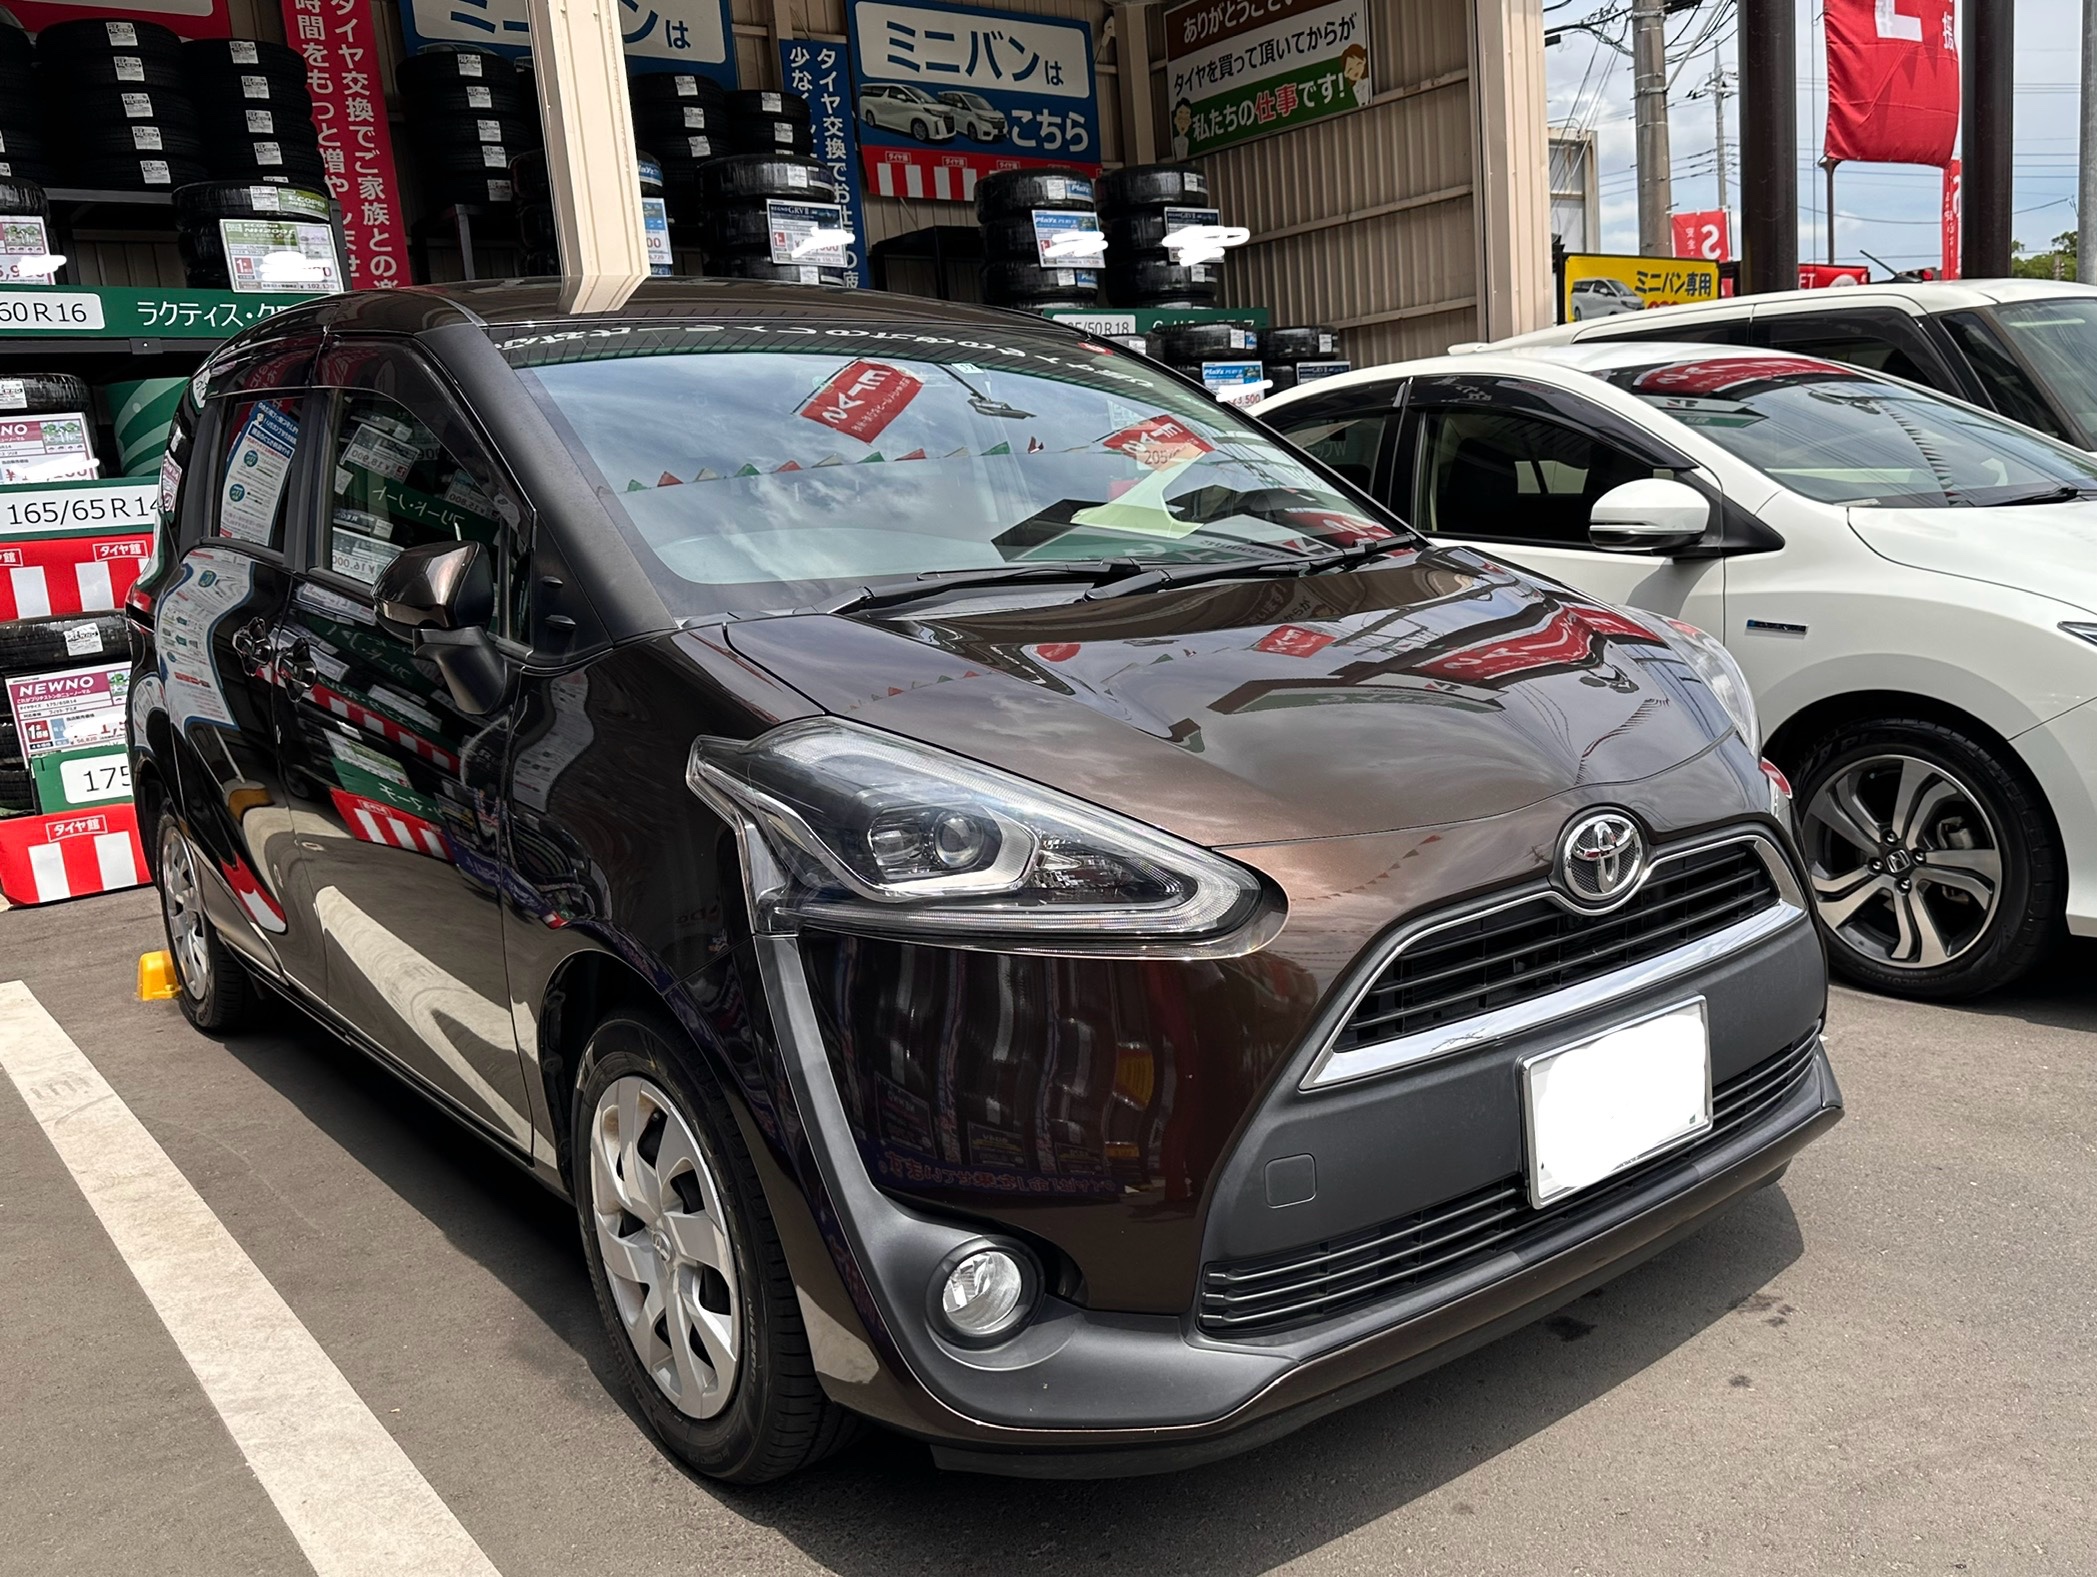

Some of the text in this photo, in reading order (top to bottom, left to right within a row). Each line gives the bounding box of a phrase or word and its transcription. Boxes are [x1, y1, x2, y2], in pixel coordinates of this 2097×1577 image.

[886, 20, 1064, 86] ミニバンは
[1011, 108, 1090, 152] こちら
[1634, 270, 1713, 297] ミニバン専用
[100, 543, 142, 557] タイヤ館
[20, 675, 95, 697] NEWNO
[53, 818, 101, 837] タイヤ館
